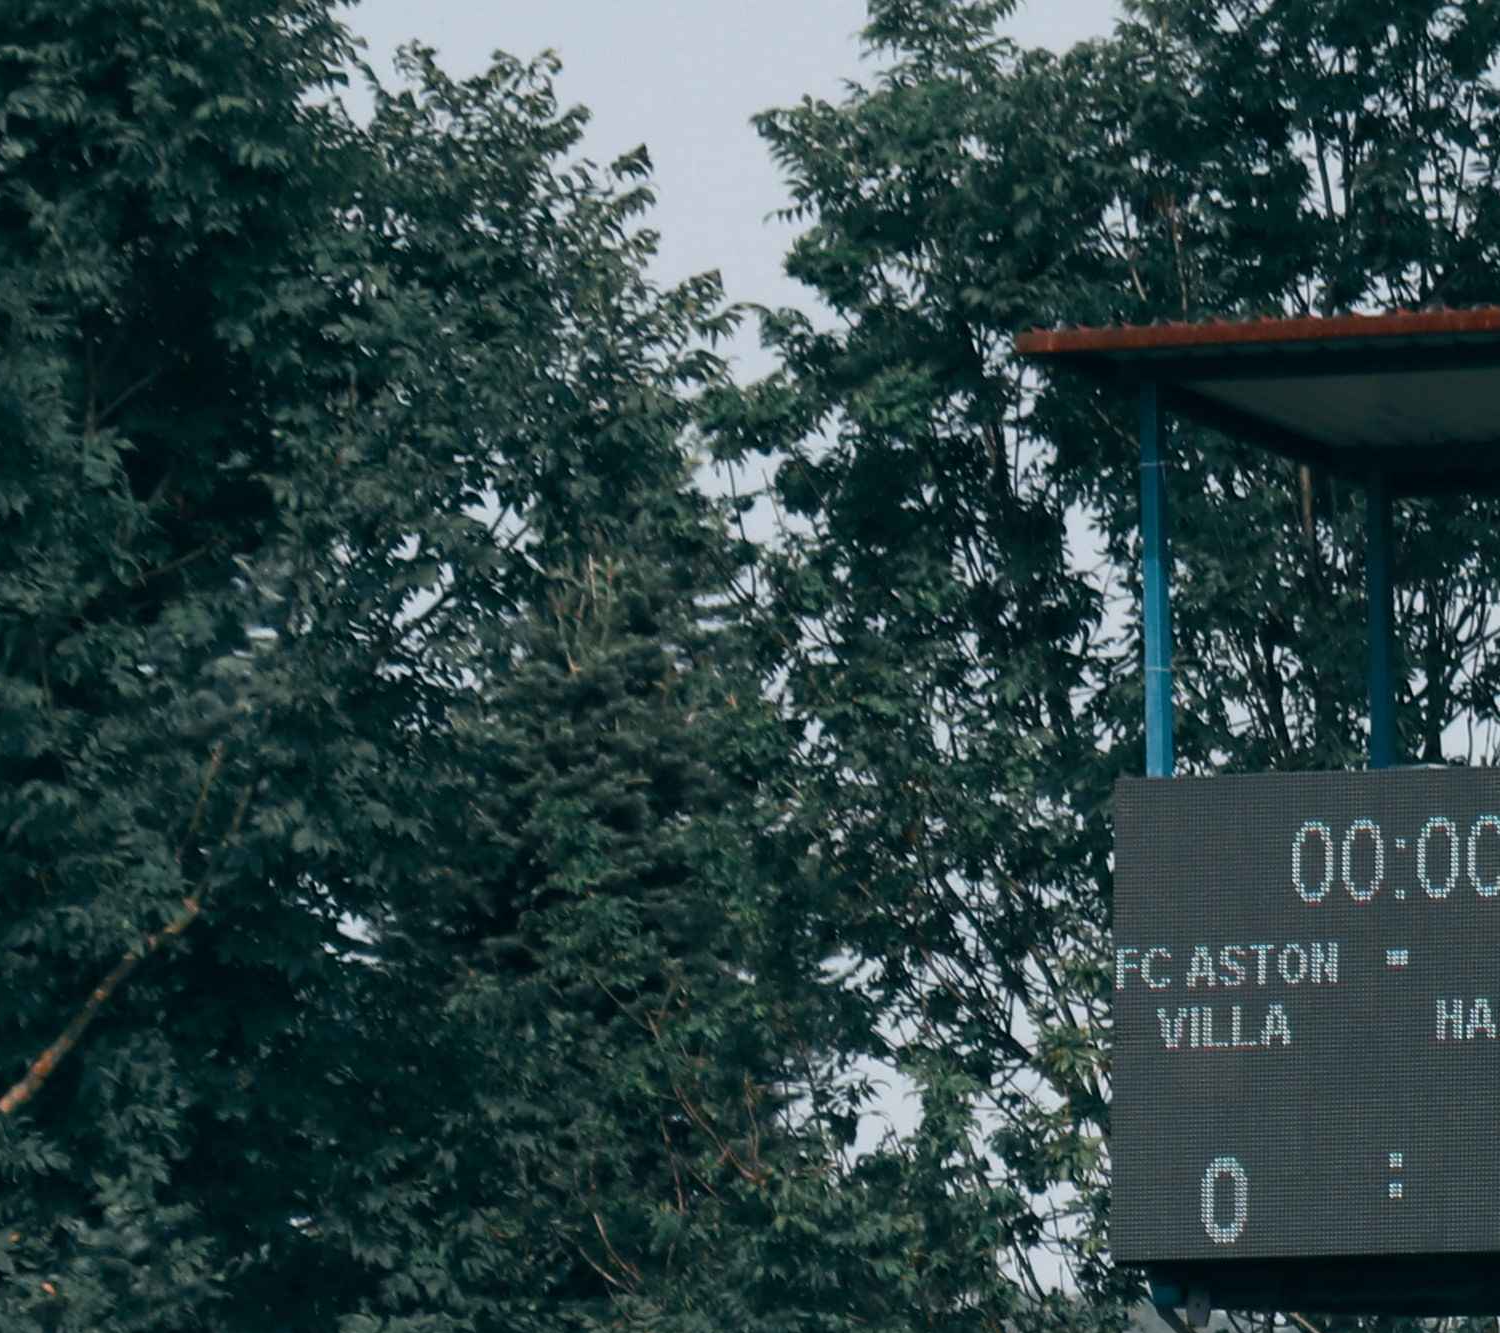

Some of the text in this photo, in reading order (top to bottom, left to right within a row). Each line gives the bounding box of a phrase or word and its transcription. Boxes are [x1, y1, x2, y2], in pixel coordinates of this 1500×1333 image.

[1115, 946, 1173, 990] FC
[1185, 942, 1339, 989] ASTON
[1156, 1004, 1292, 1049] VILLA
[1200, 1156, 1249, 1245] 0
